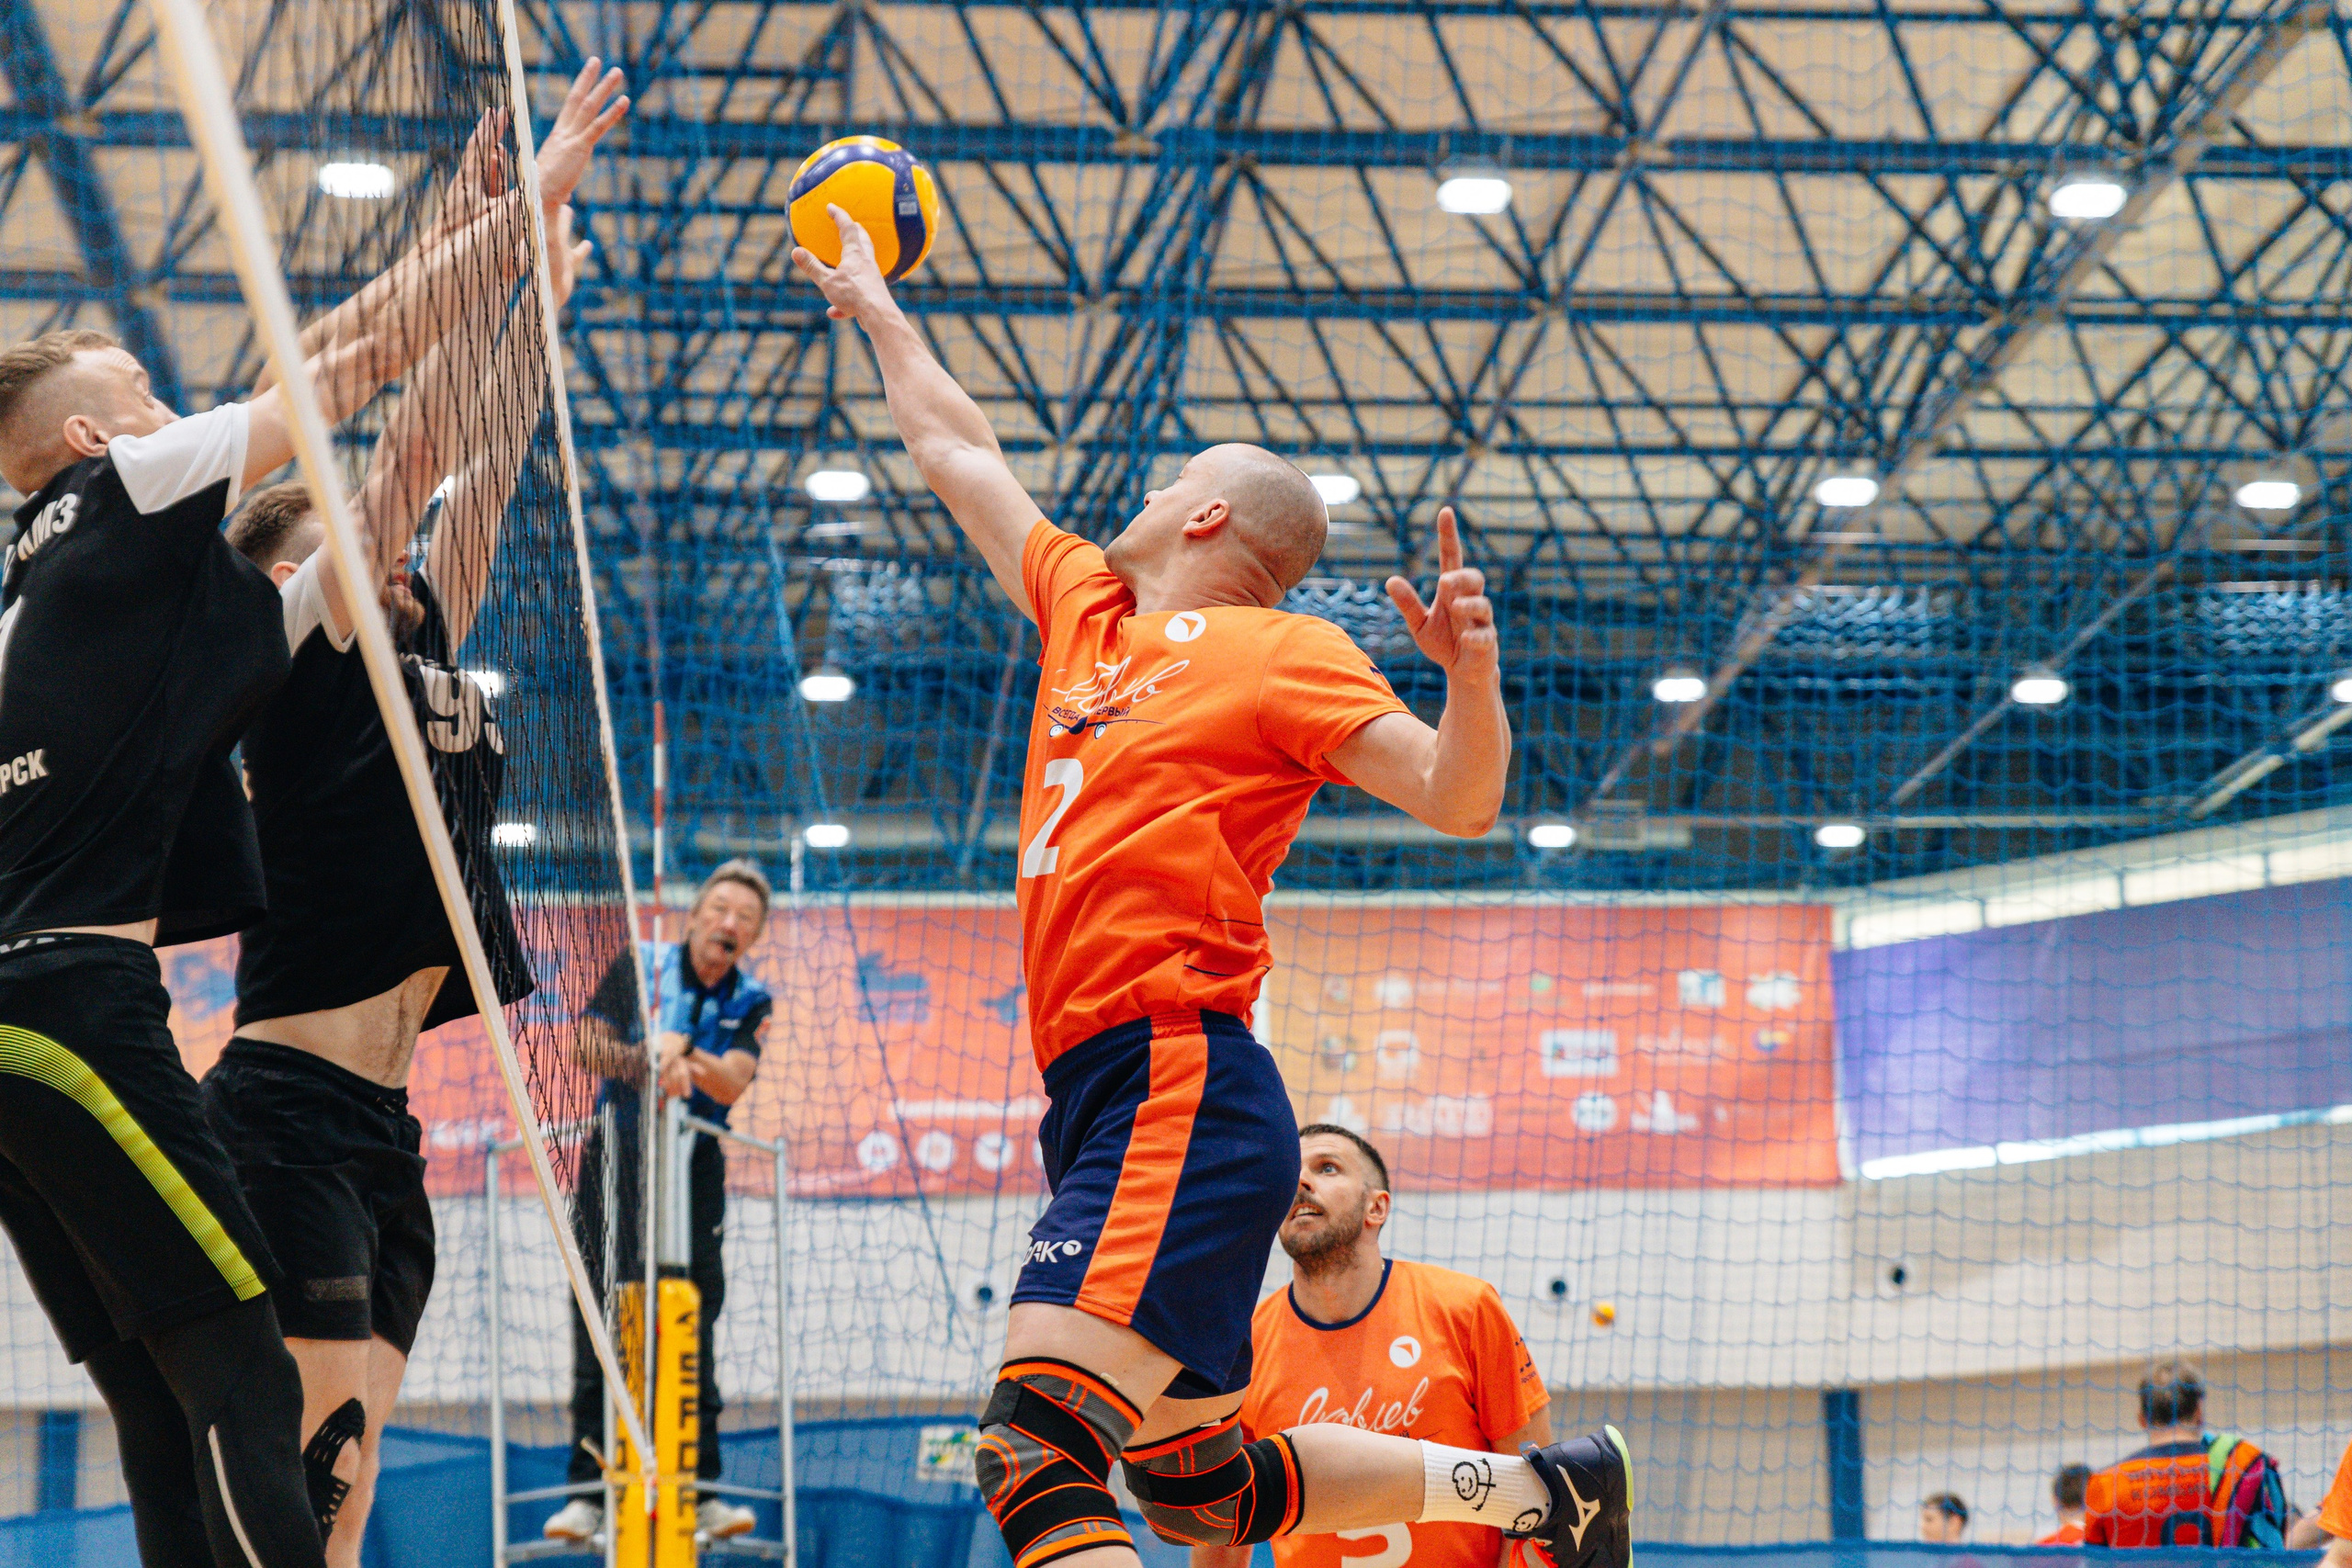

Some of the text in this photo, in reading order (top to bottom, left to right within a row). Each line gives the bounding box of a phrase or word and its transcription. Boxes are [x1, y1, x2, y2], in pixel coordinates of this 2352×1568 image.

[1093, 705, 1131, 717] ЕРВЫЙ
[0, 748, 48, 795] РСК
[1022, 758, 1084, 878] 2
[1022, 1240, 1064, 1268] АК
